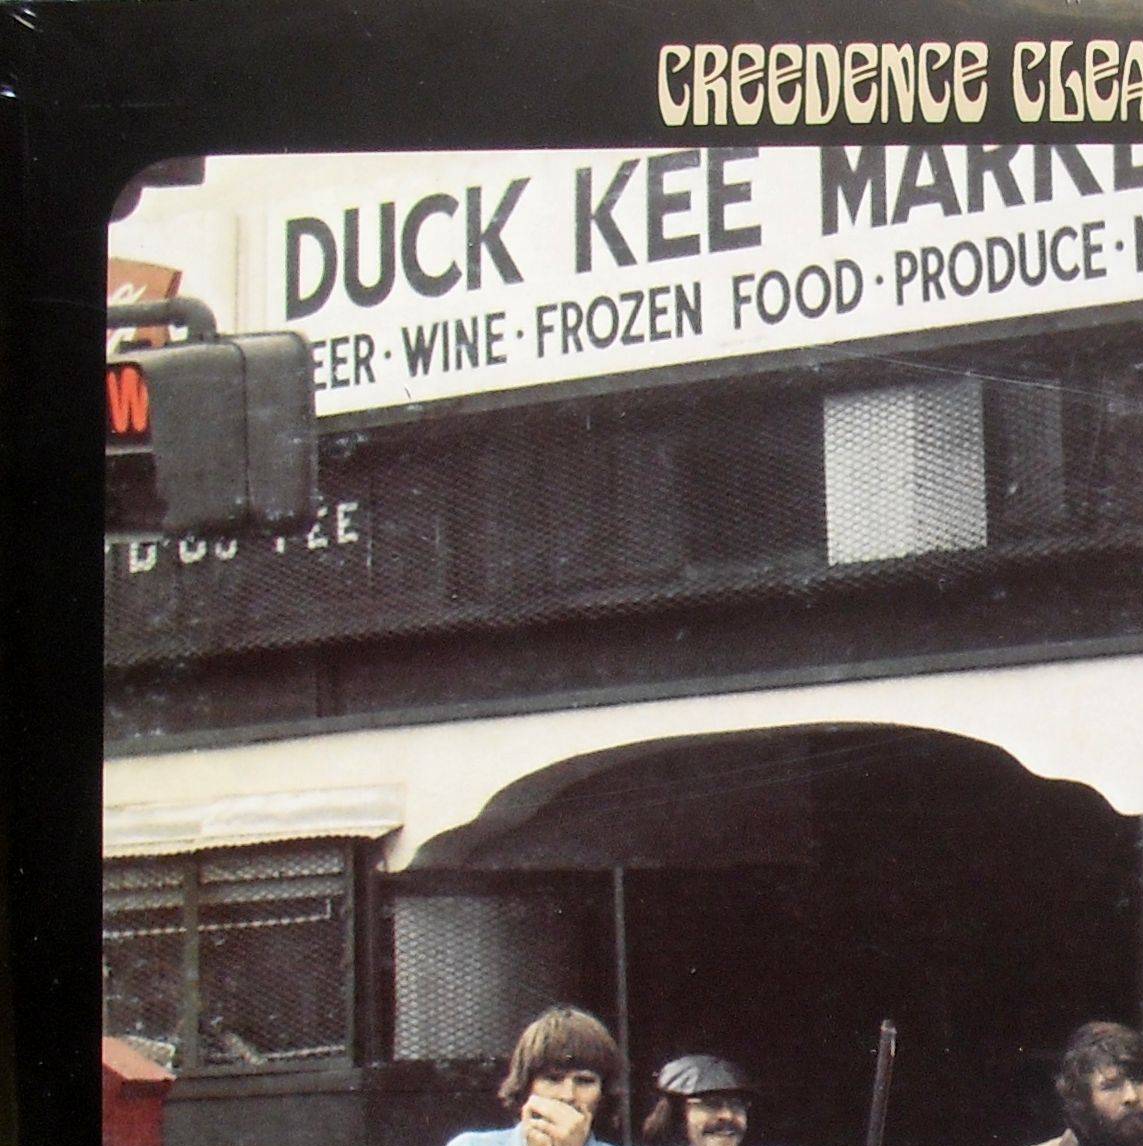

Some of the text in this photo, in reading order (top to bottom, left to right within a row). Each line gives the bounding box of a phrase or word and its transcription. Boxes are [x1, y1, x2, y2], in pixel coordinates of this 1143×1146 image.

[658, 43, 989, 126] CREEDENCE
[285, 176, 531, 322] DUCK
[574, 147, 762, 273] KEE
[309, 333, 377, 391] EER
[401, 311, 508, 378] WINE
[535, 281, 703, 359] FROZEN
[731, 258, 864, 331] FOOD
[894, 219, 1107, 307] PRODUCE
